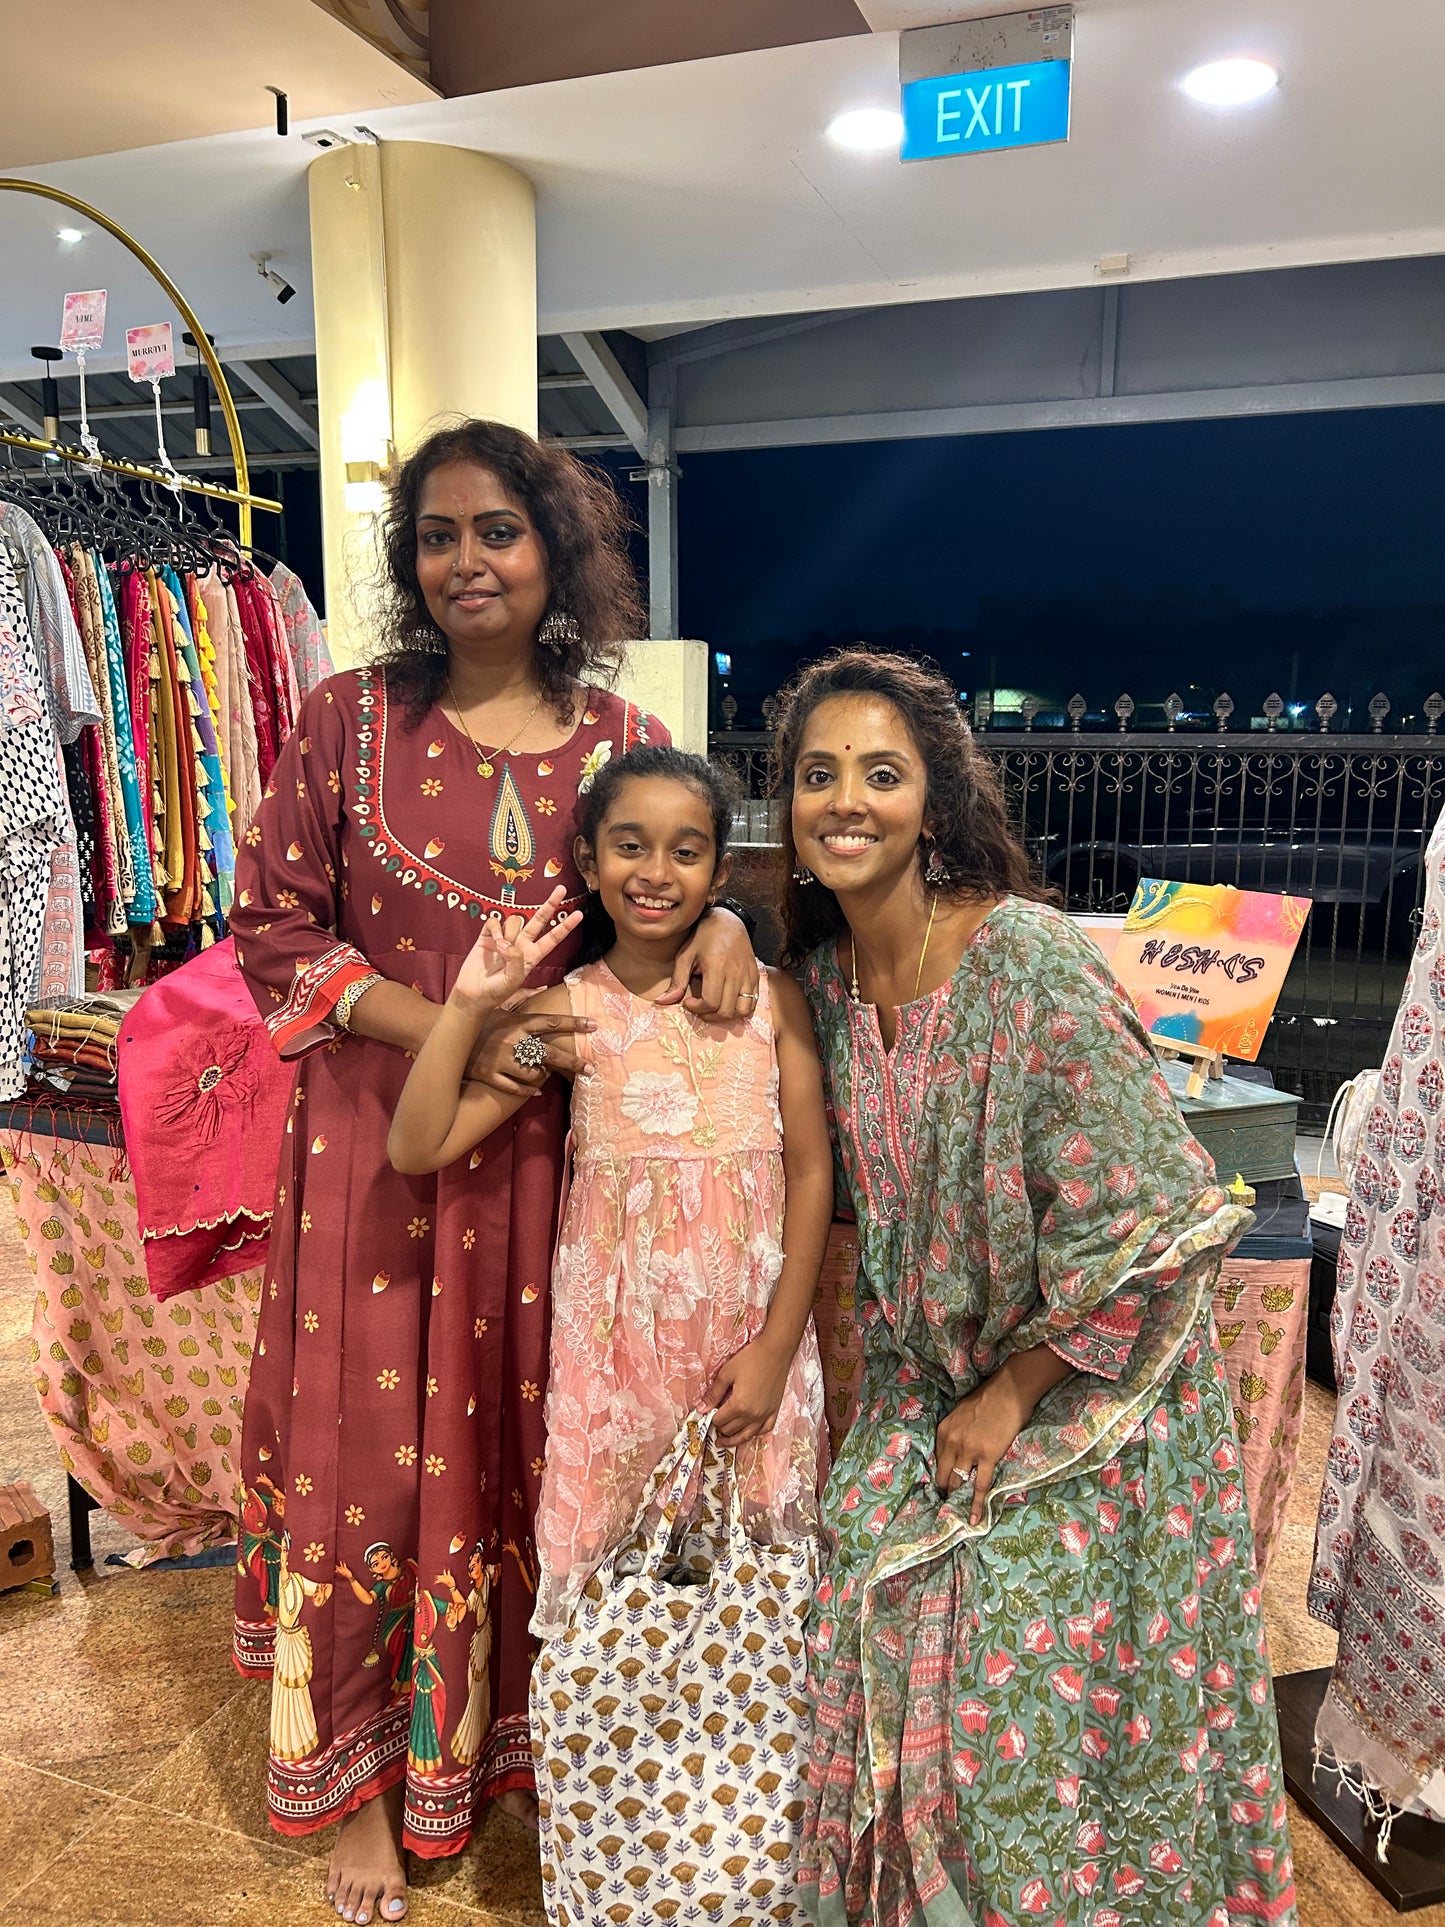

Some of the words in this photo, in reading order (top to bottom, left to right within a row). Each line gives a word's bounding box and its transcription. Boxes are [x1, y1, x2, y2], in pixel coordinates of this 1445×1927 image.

[936, 79, 1031, 143] EXIT
[132, 344, 167, 357] MURRAYA
[1155, 989, 1177, 998] WOMEN
[1181, 994, 1194, 1002] MEN
[1197, 997, 1210, 1006] KIDS
